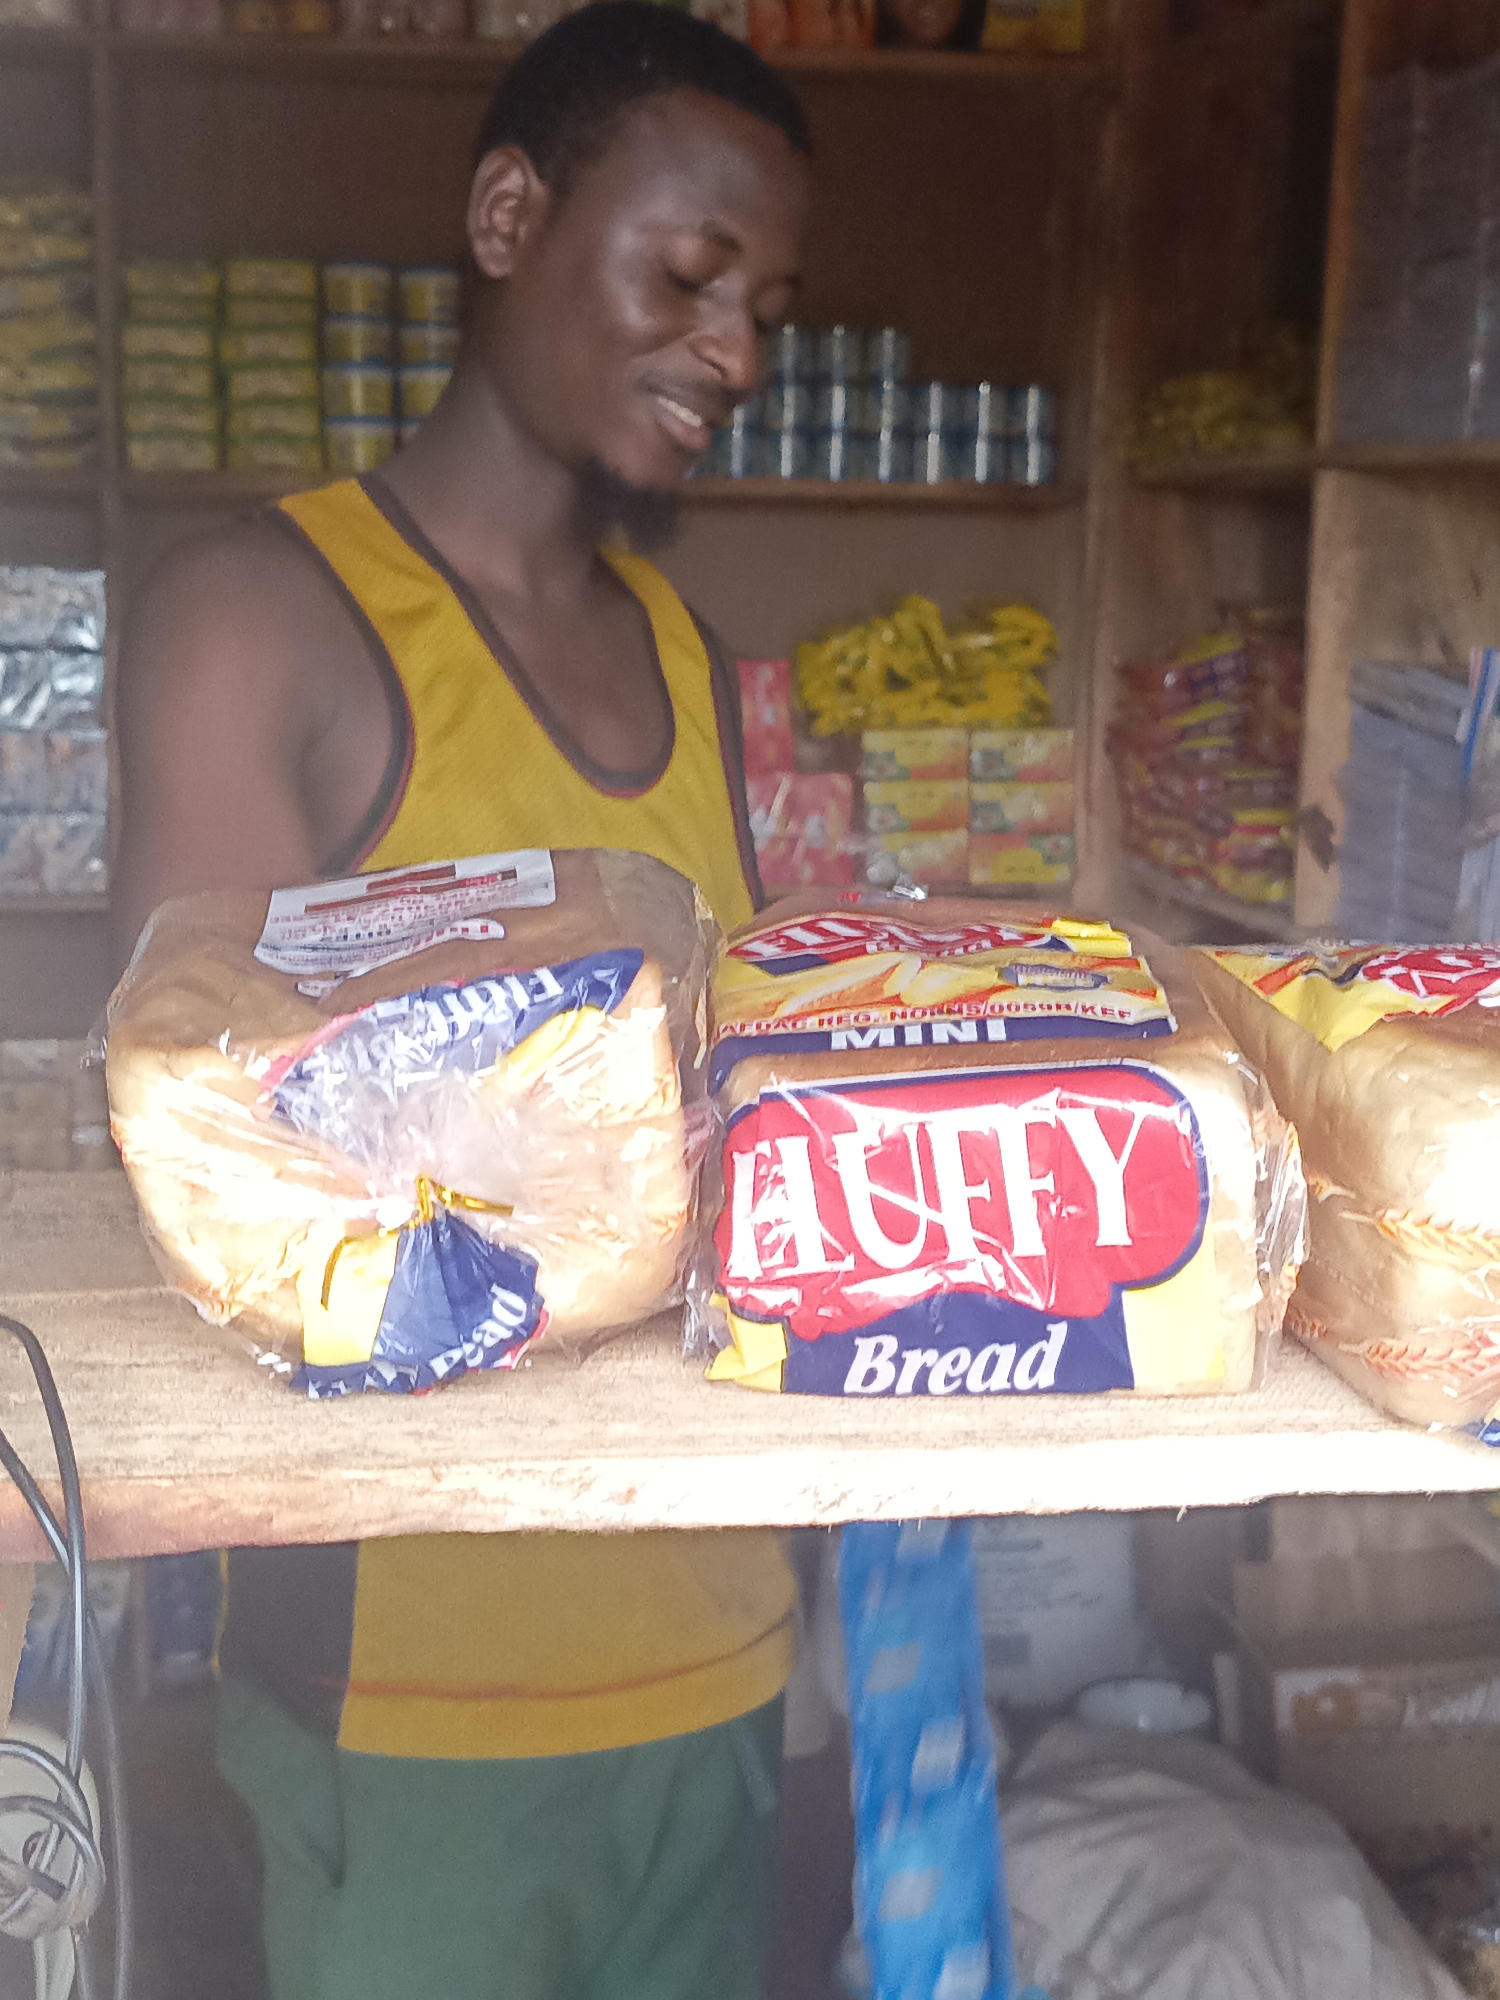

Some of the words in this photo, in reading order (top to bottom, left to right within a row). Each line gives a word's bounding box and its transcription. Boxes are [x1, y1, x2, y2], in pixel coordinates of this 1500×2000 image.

[830, 1019, 1007, 1050] MINI
[724, 1103, 1148, 1281] FLUFFY
[843, 1321, 1069, 1395] Bread
